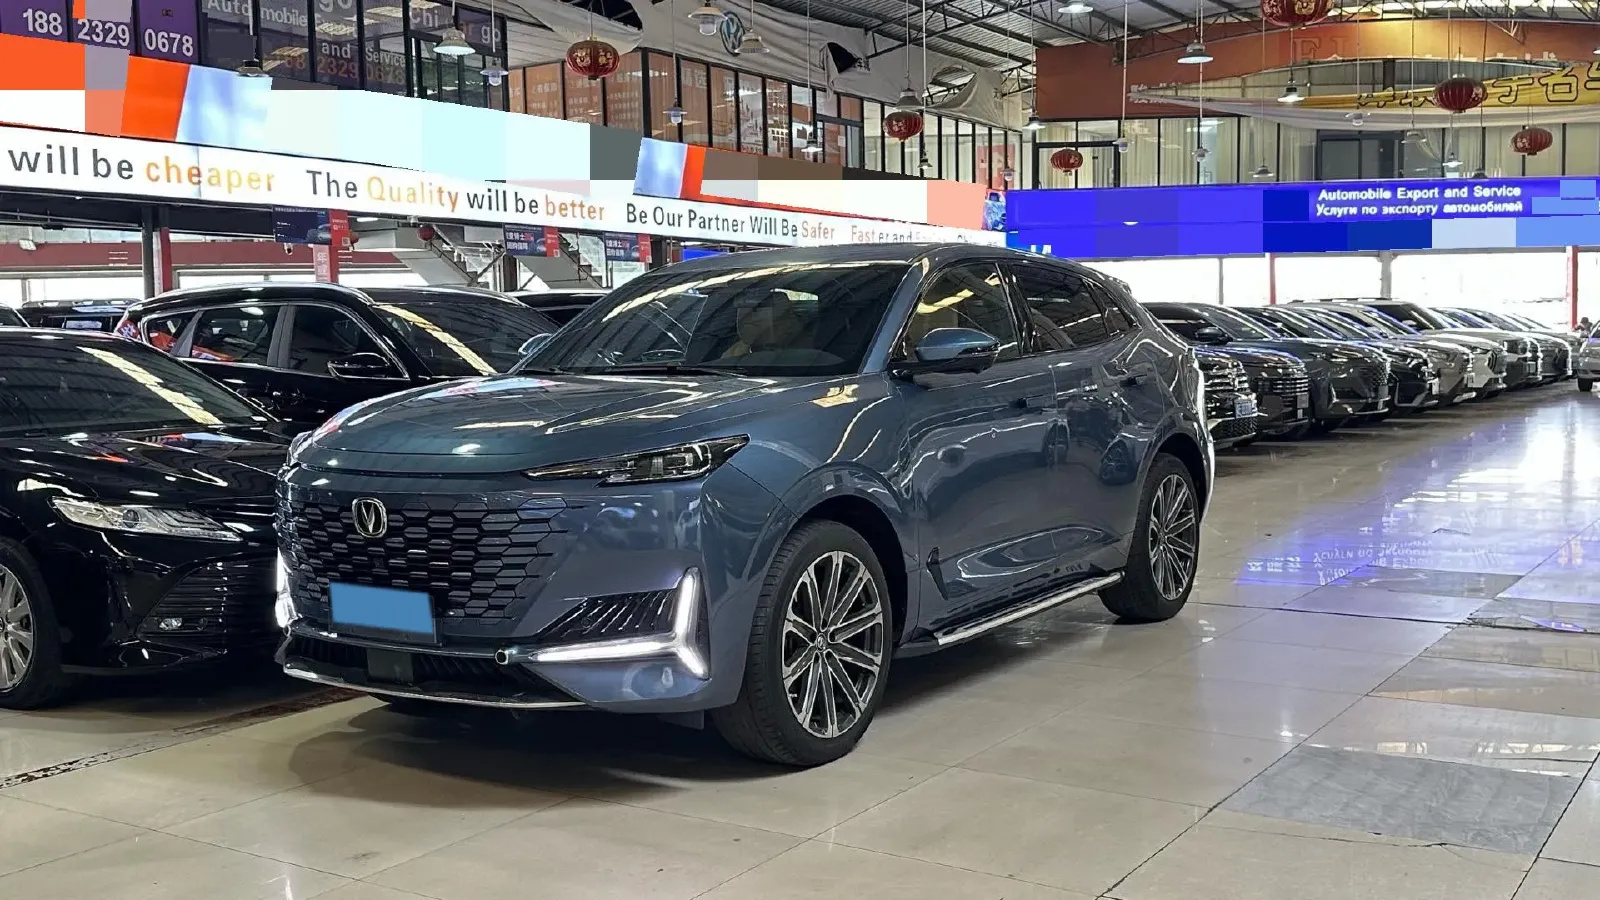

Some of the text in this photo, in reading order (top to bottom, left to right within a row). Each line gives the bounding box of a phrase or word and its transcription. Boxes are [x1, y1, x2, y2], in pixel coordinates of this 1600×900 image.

[23, 8, 194, 57] 188 2329 0678
[322, 42, 406, 67] and Service
[8, 143, 275, 195] will be cheaper
[306, 170, 605, 220] The Quality will be better
[1316, 204, 1358, 218] Услуги
[1361, 204, 1378, 215] по
[1382, 204, 1437, 218] экспорту
[1318, 186, 1522, 201] Automobile Export and Service
[626, 202, 836, 241] Be Our Partner Will Be Safer
